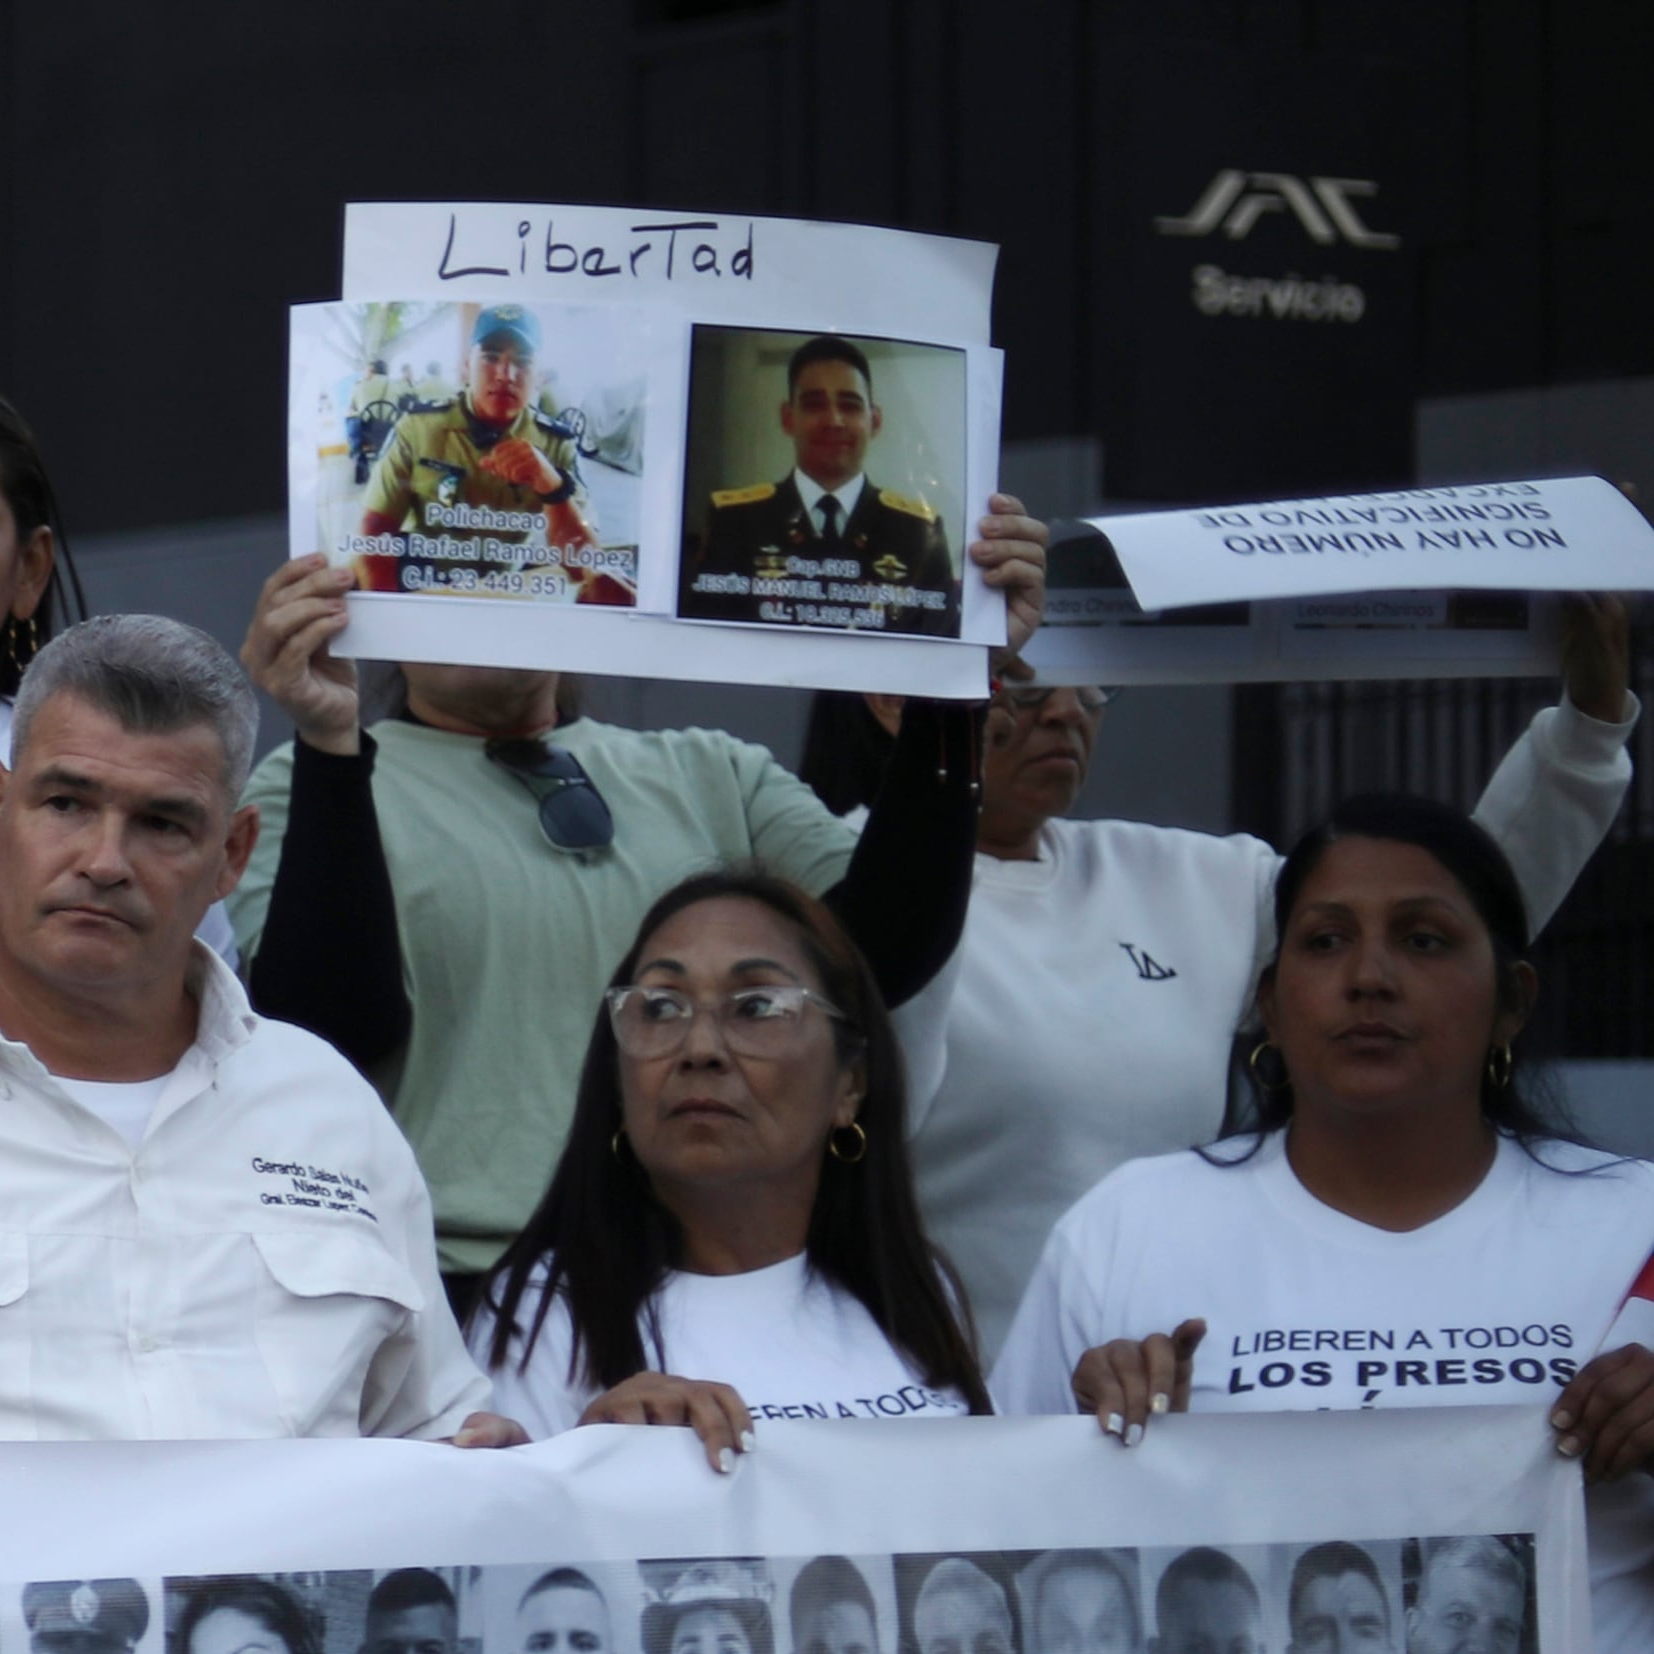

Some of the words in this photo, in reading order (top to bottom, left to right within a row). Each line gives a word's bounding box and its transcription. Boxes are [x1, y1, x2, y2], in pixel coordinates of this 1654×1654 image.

[1192, 264, 1365, 323] Servicio
[426, 504, 547, 531] Polichacao
[1260, 502, 1551, 527] SIGNIFICATIVO
[338, 533, 405, 558] Jesús
[408, 534, 480, 560] Rafael
[483, 541, 561, 566] Ramos
[566, 544, 633, 570] López
[1223, 531, 1405, 557] NÚMERO
[1417, 529, 1498, 551] HAY
[1504, 527, 1568, 550] NO
[252, 1157, 306, 1177] Gerardo
[1231, 1329, 1394, 1358] LIBEREN
[1405, 1329, 1433, 1351] A
[1439, 1324, 1574, 1350] TODOS
[1228, 1360, 1333, 1395] LOS
[1356, 1356, 1578, 1388] PRESOS
